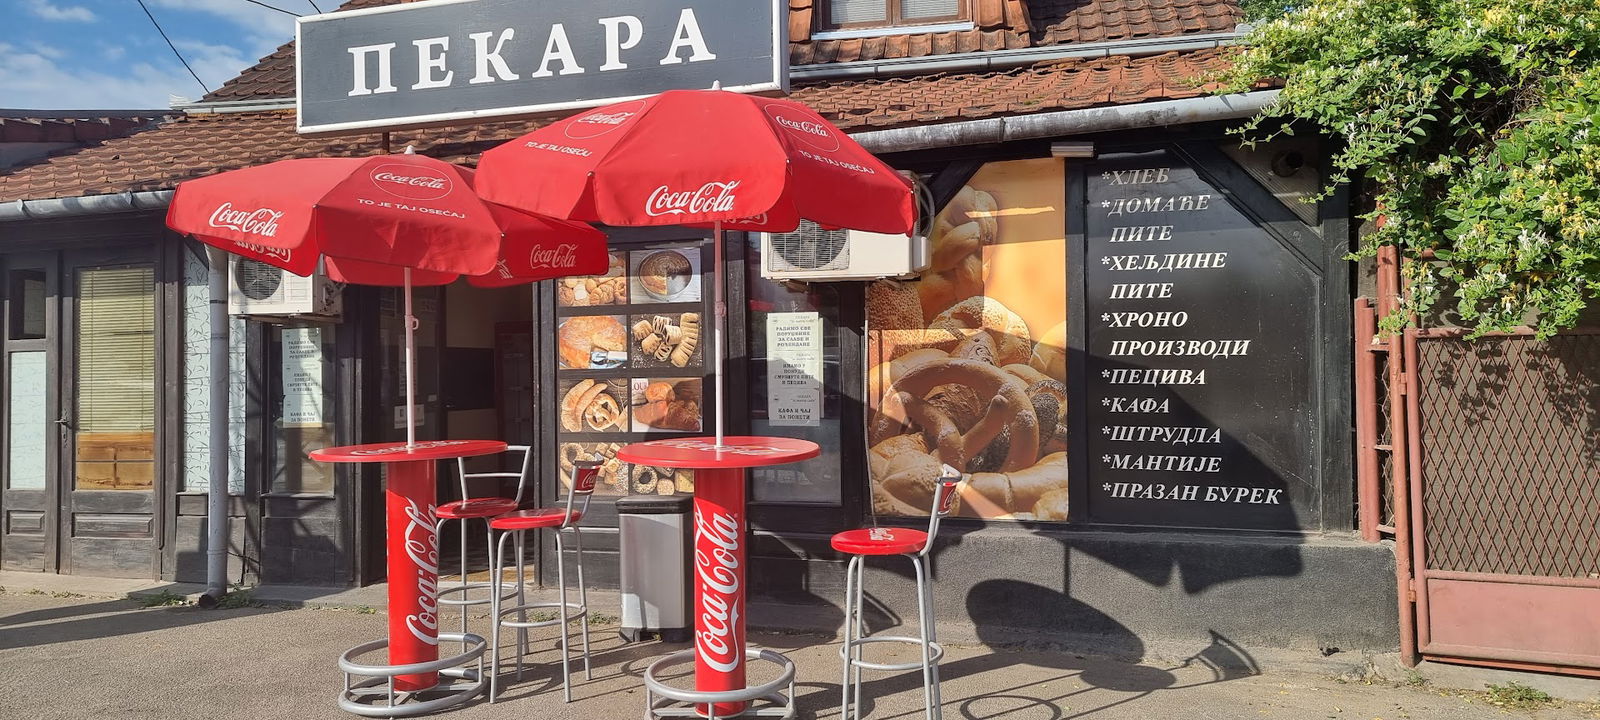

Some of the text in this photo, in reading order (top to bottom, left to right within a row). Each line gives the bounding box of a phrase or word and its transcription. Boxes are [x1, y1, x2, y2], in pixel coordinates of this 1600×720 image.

[347, 7, 717, 97] ПЕКАРА
[357, 198, 375, 206] TO
[394, 203, 416, 212] TAJ
[419, 207, 466, 219] OSEĆAJ
[1109, 225, 1174, 243] ПИТЕ
[1109, 282, 1174, 300] ПИТЕ
[1109, 339, 1251, 359] ПРОИЗВОДИ
[1204, 486, 1283, 505] БУРЕК
